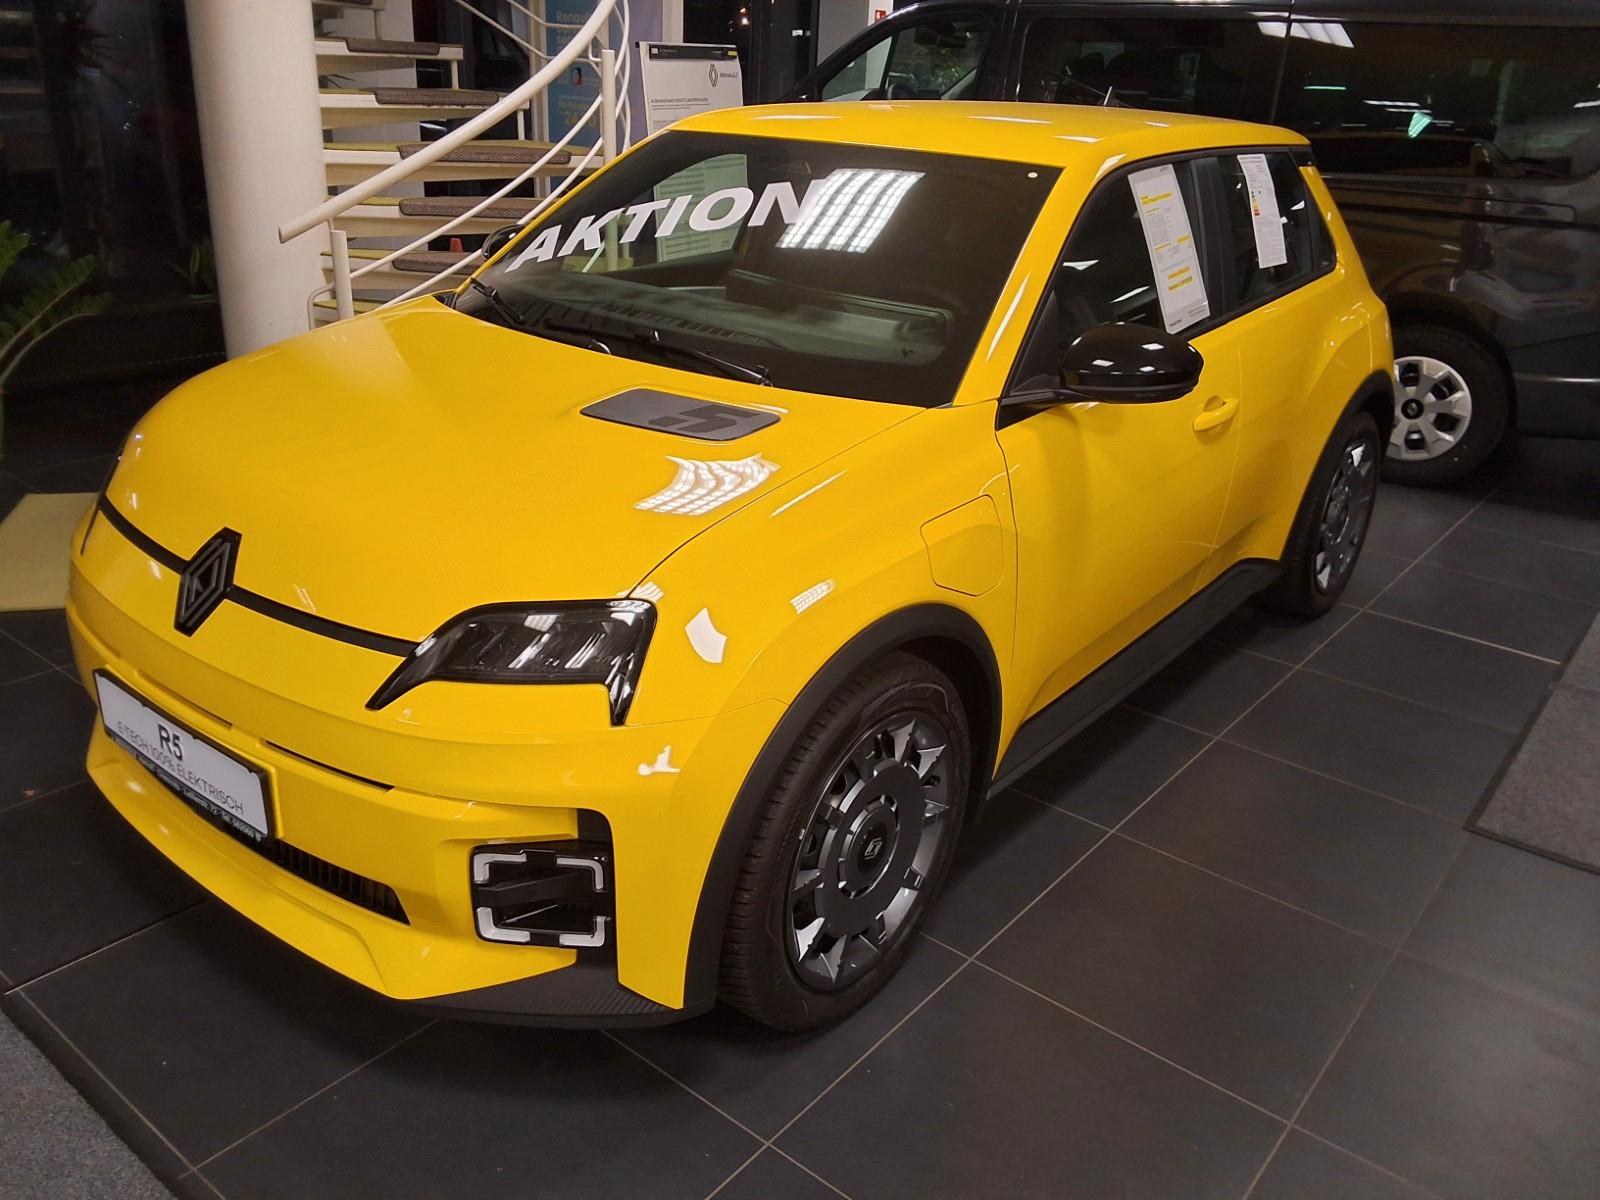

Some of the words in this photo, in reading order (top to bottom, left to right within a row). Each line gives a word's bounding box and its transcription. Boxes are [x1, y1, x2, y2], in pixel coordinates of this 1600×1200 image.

[503, 177, 829, 274] AKTION
[157, 722, 183, 761] R5
[176, 763, 245, 816] ELEKTRISCH
